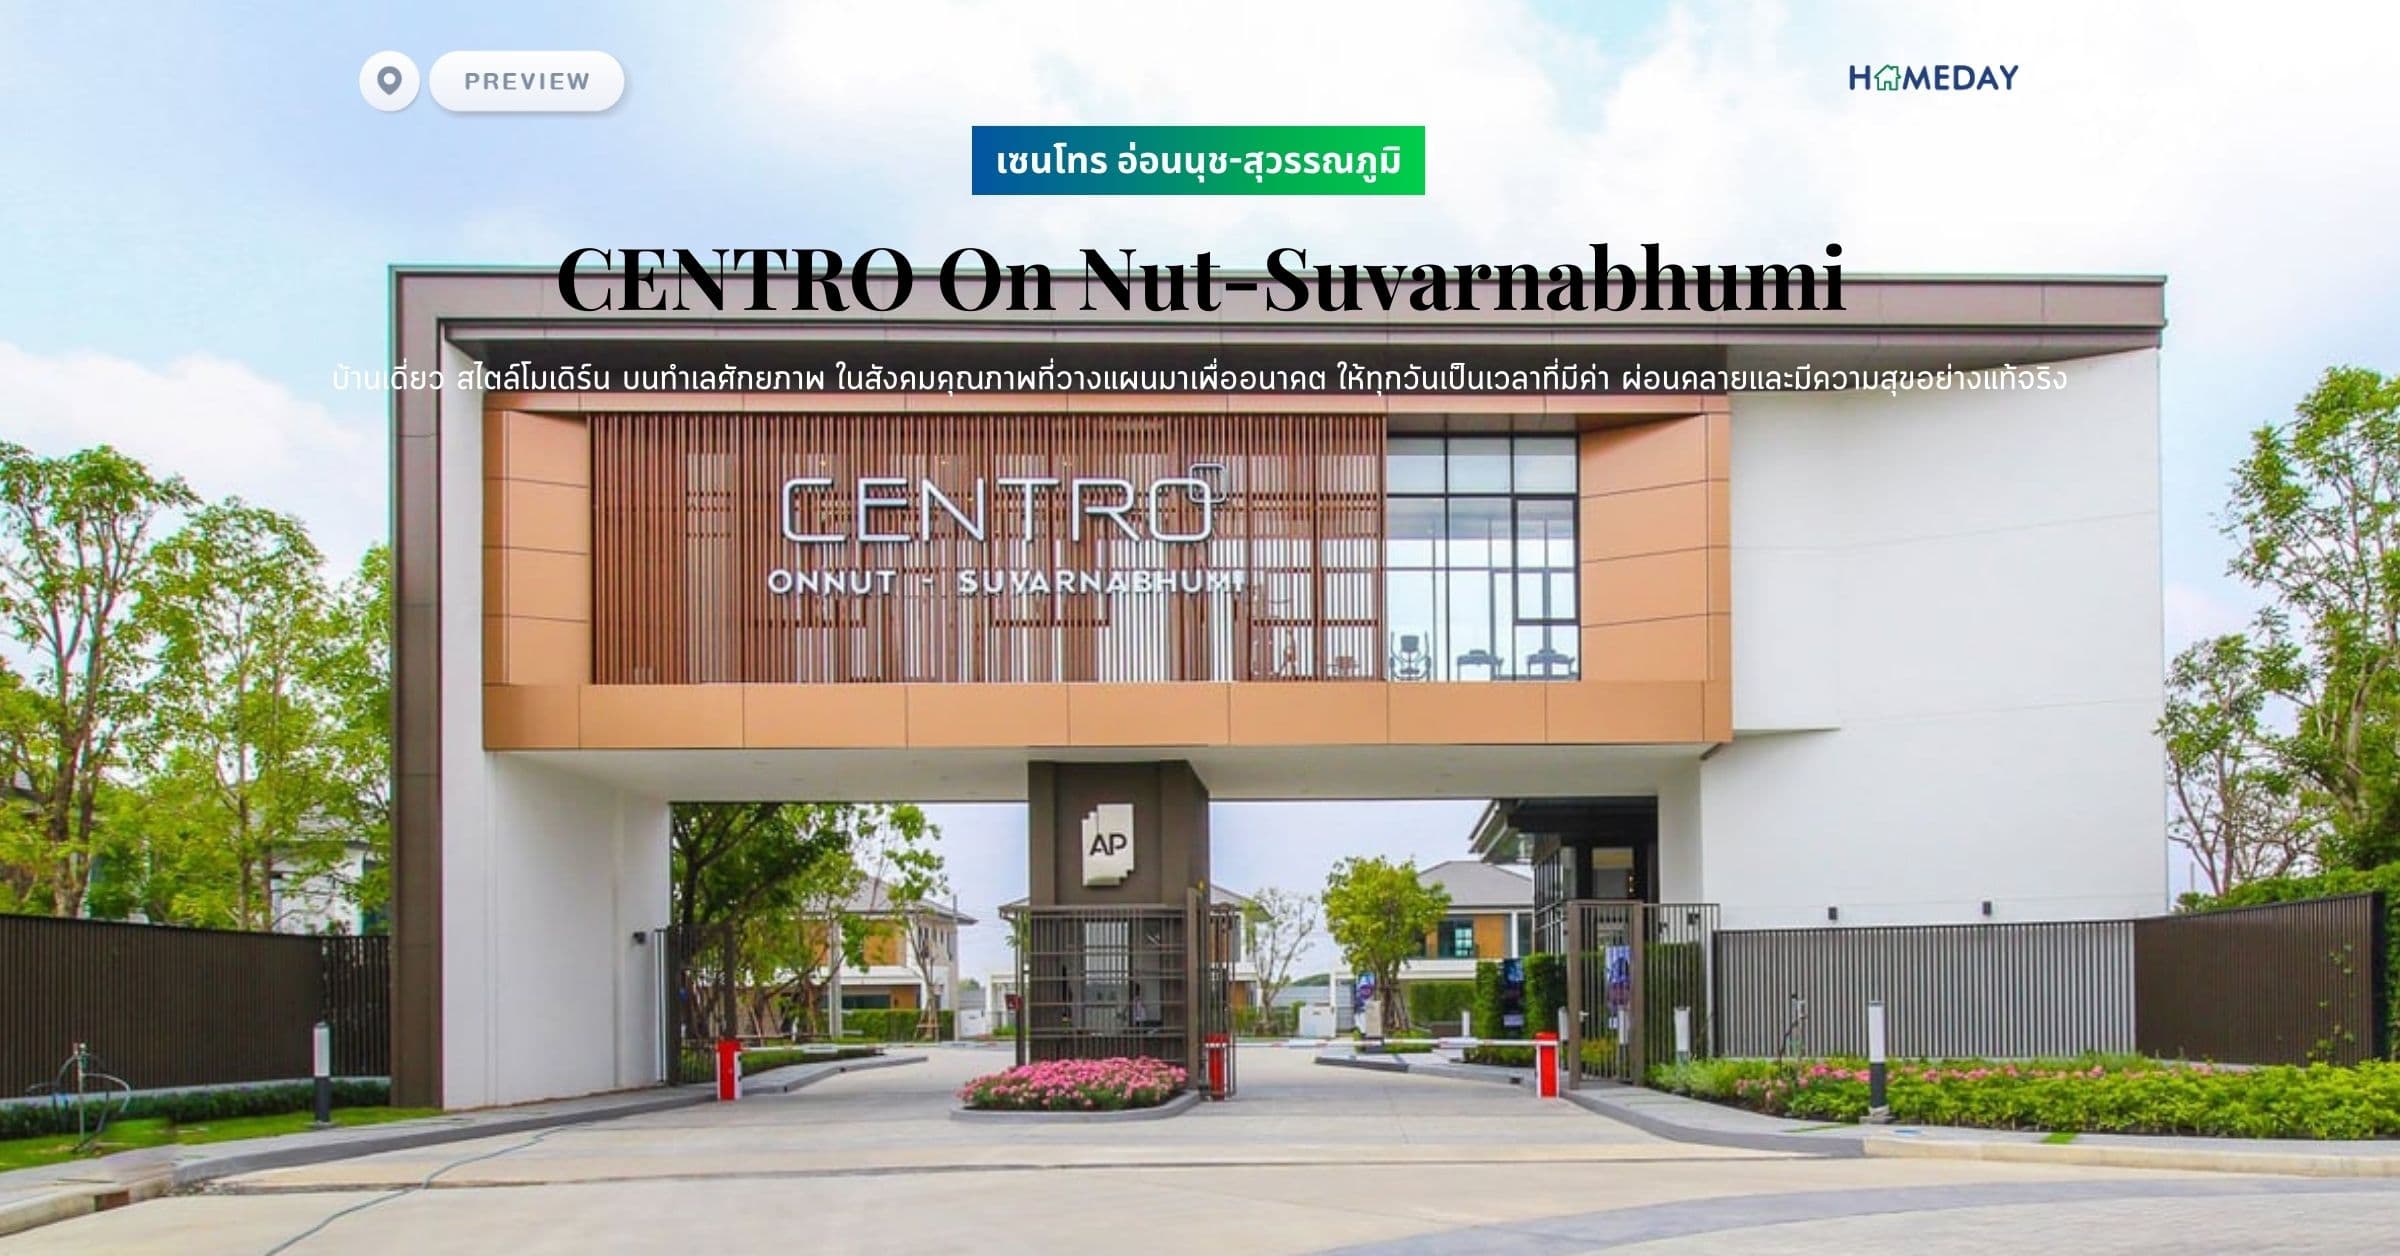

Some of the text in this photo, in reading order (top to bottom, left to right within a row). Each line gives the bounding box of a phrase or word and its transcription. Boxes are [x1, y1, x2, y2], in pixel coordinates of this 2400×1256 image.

[781, 476, 1213, 544] CENTRO
[767, 569, 897, 595] ONNUT
[957, 569, 1245, 596] SUVARNABHUMI
[1089, 833, 1127, 856] AP
